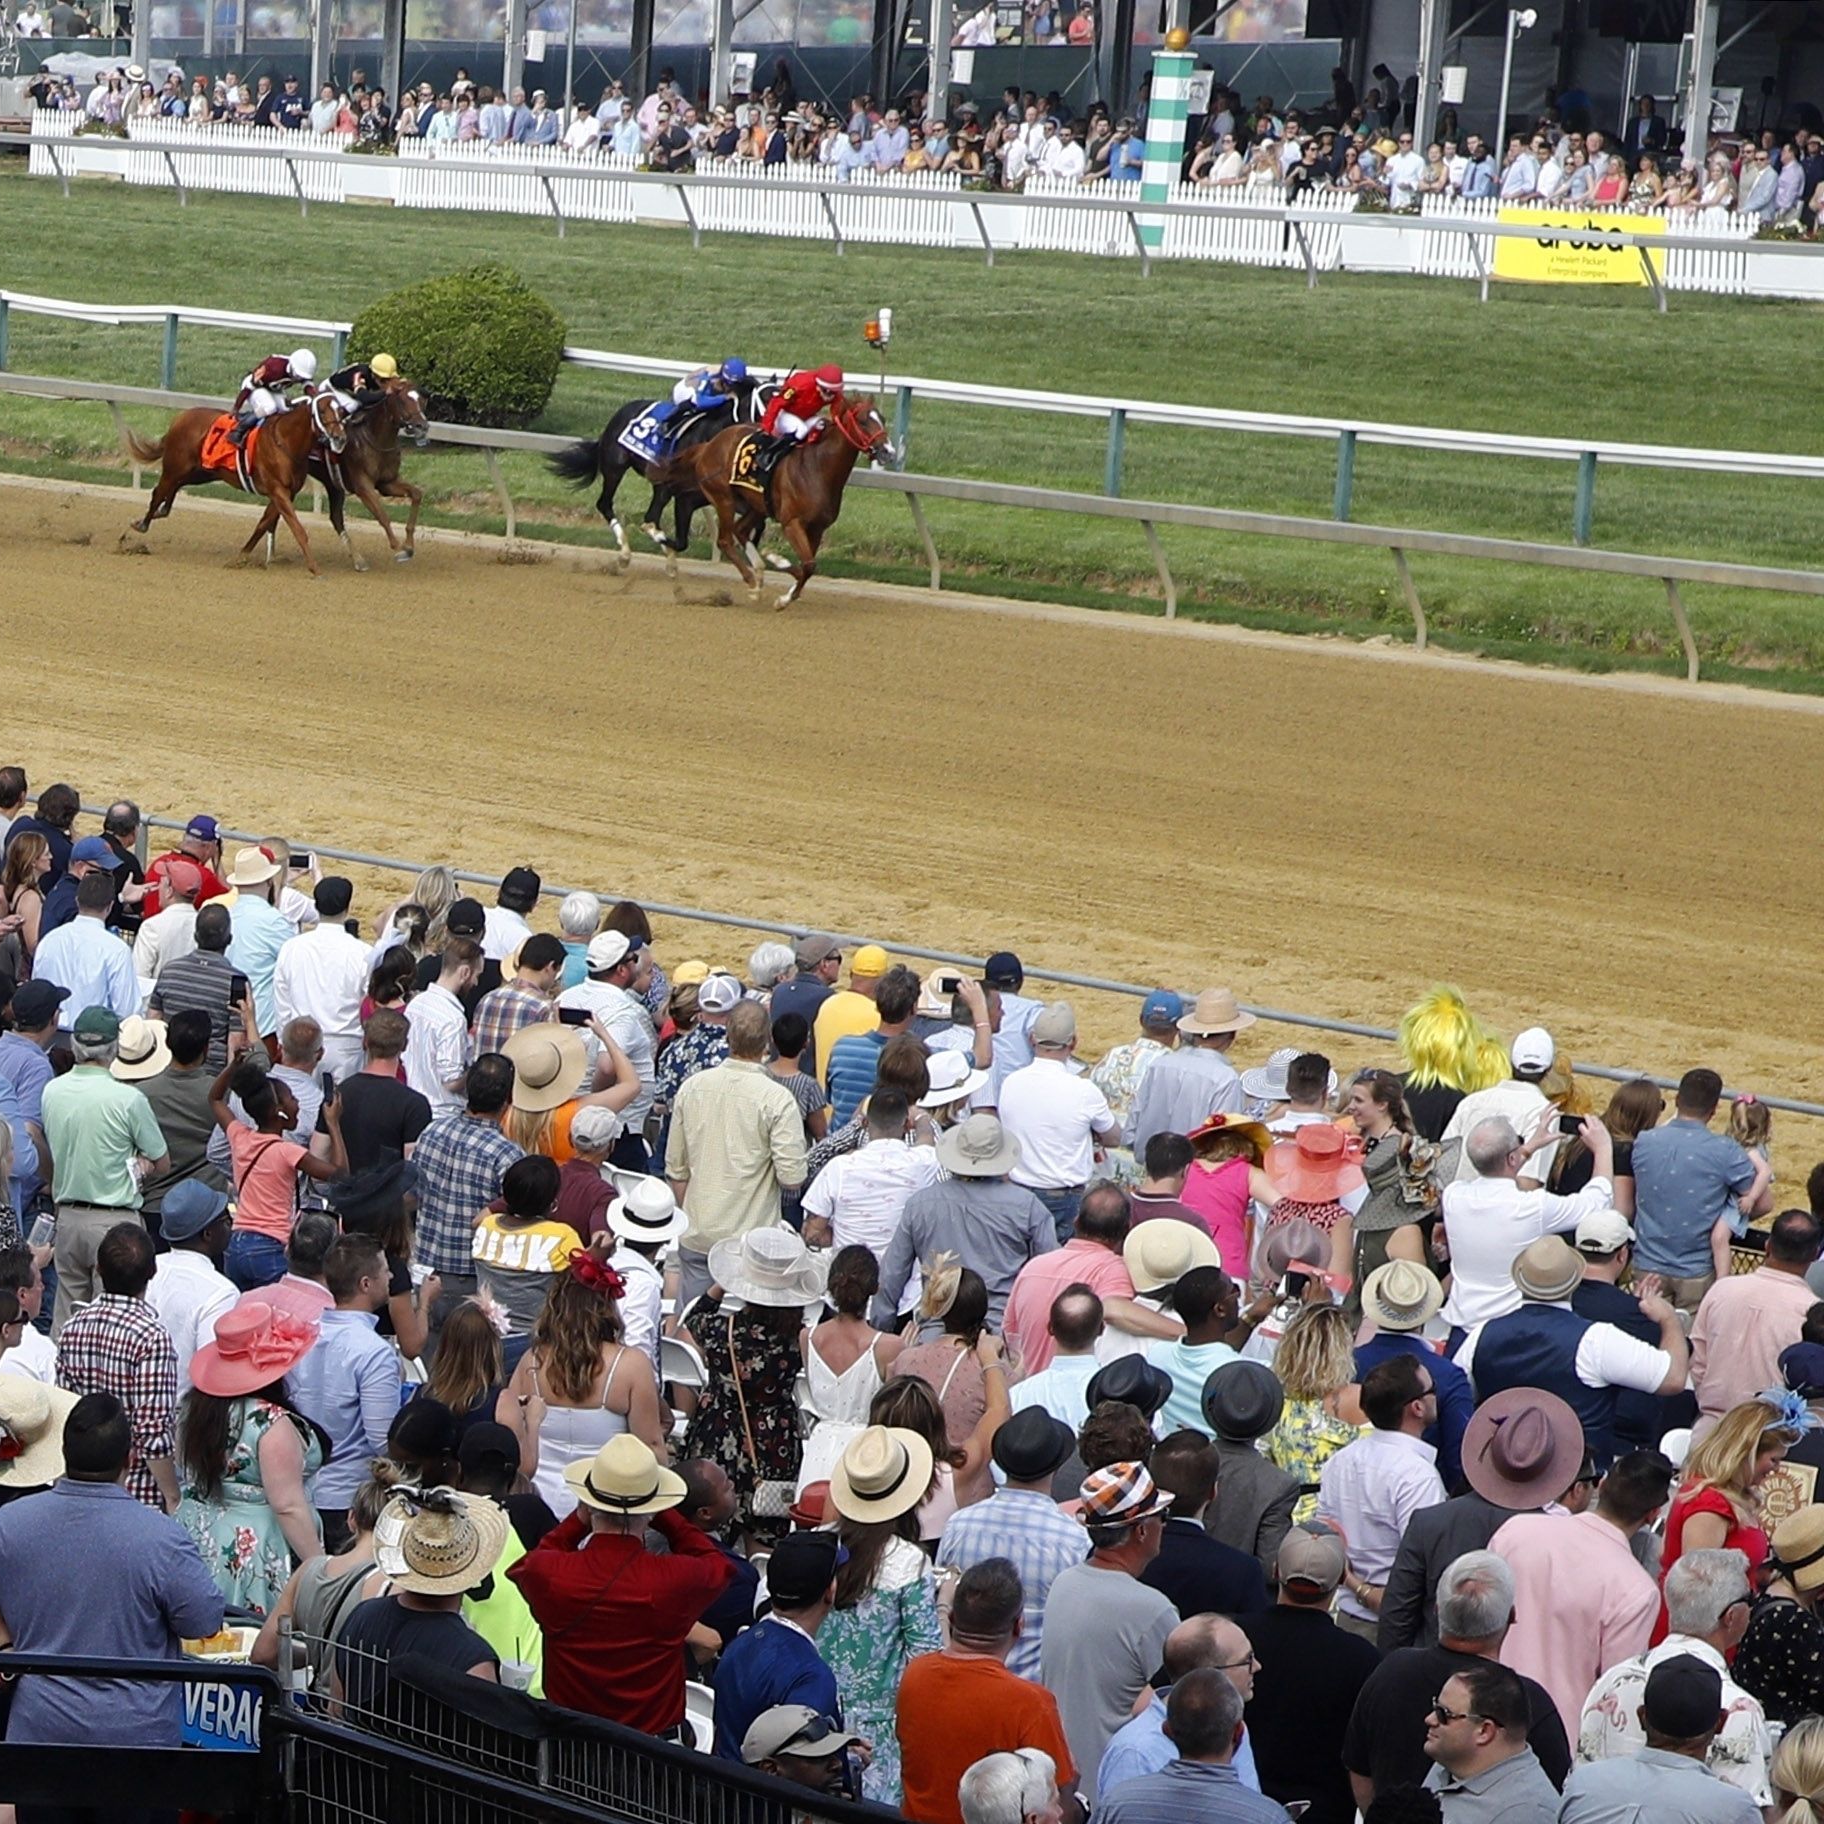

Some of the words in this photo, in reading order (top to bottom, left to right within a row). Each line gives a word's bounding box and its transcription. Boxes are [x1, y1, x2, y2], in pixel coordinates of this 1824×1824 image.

[207, 427, 226, 455] 7
[633, 417, 657, 439] 3
[739, 443, 757, 475] 6
